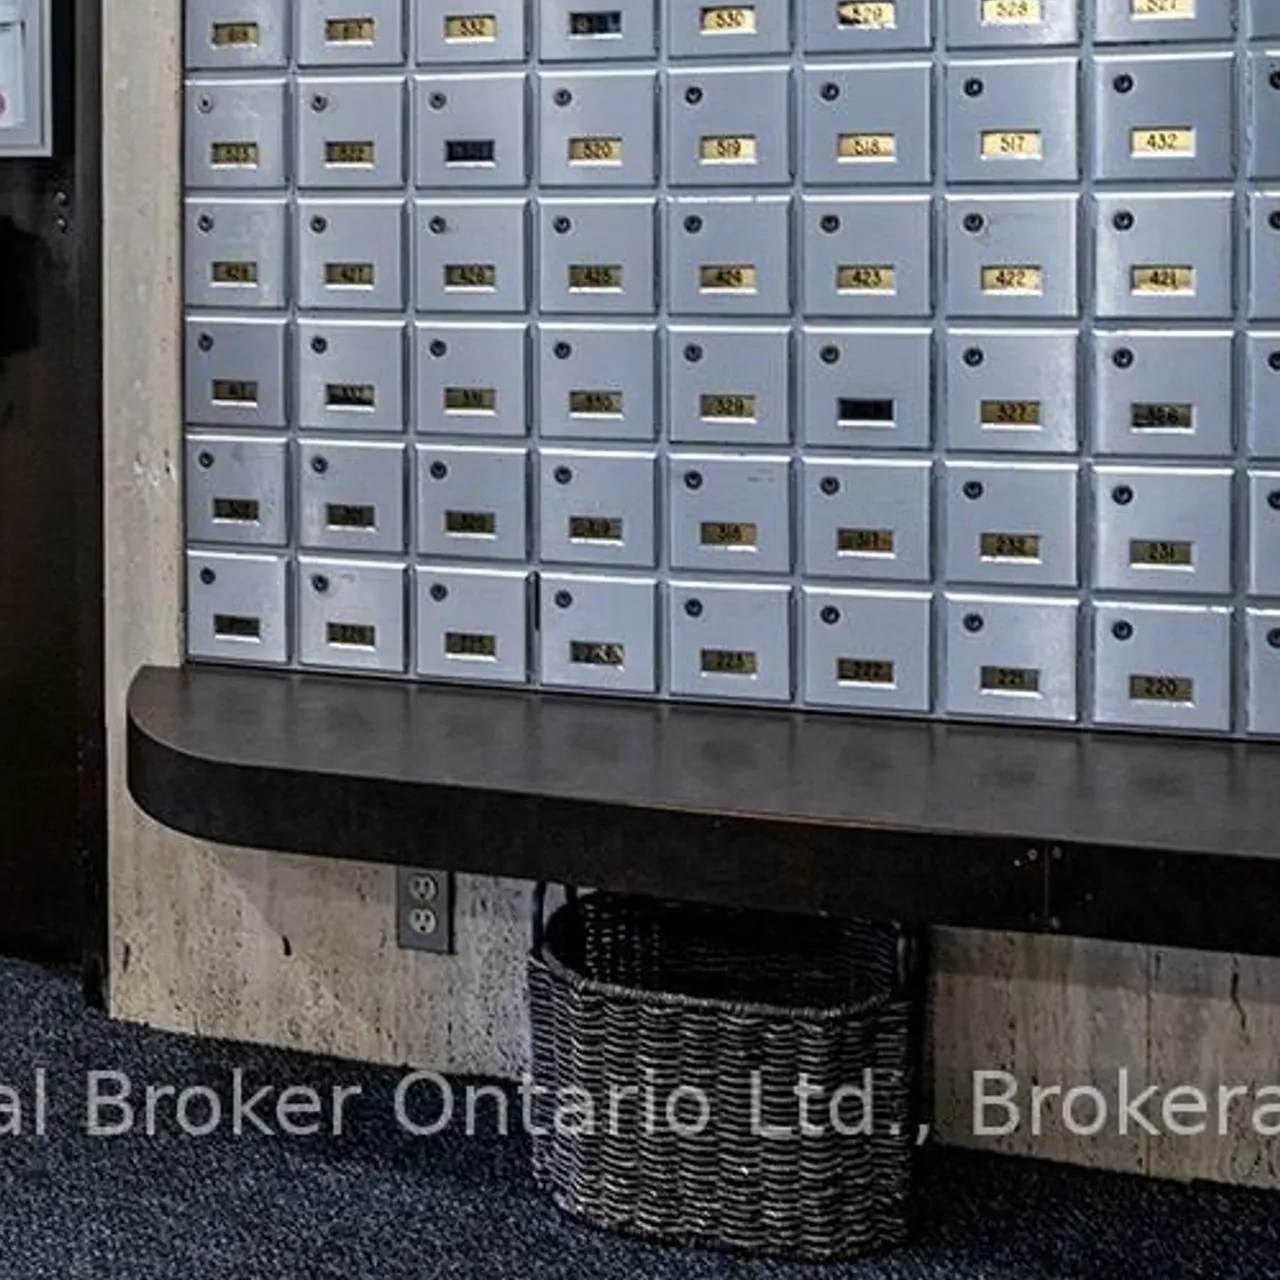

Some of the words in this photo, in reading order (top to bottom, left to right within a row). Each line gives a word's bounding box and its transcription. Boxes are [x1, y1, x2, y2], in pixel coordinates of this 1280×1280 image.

[717, 139, 741, 155] 519
[854, 140, 880, 155] 518
[1001, 136, 1024, 152] 517
[1146, 133, 1178, 150] 432
[853, 270, 881, 285] 423
[996, 271, 1025, 285] 422
[1150, 271, 1176, 287] 421
[997, 403, 1026, 420] 327
[1150, 543, 1175, 560] 231
